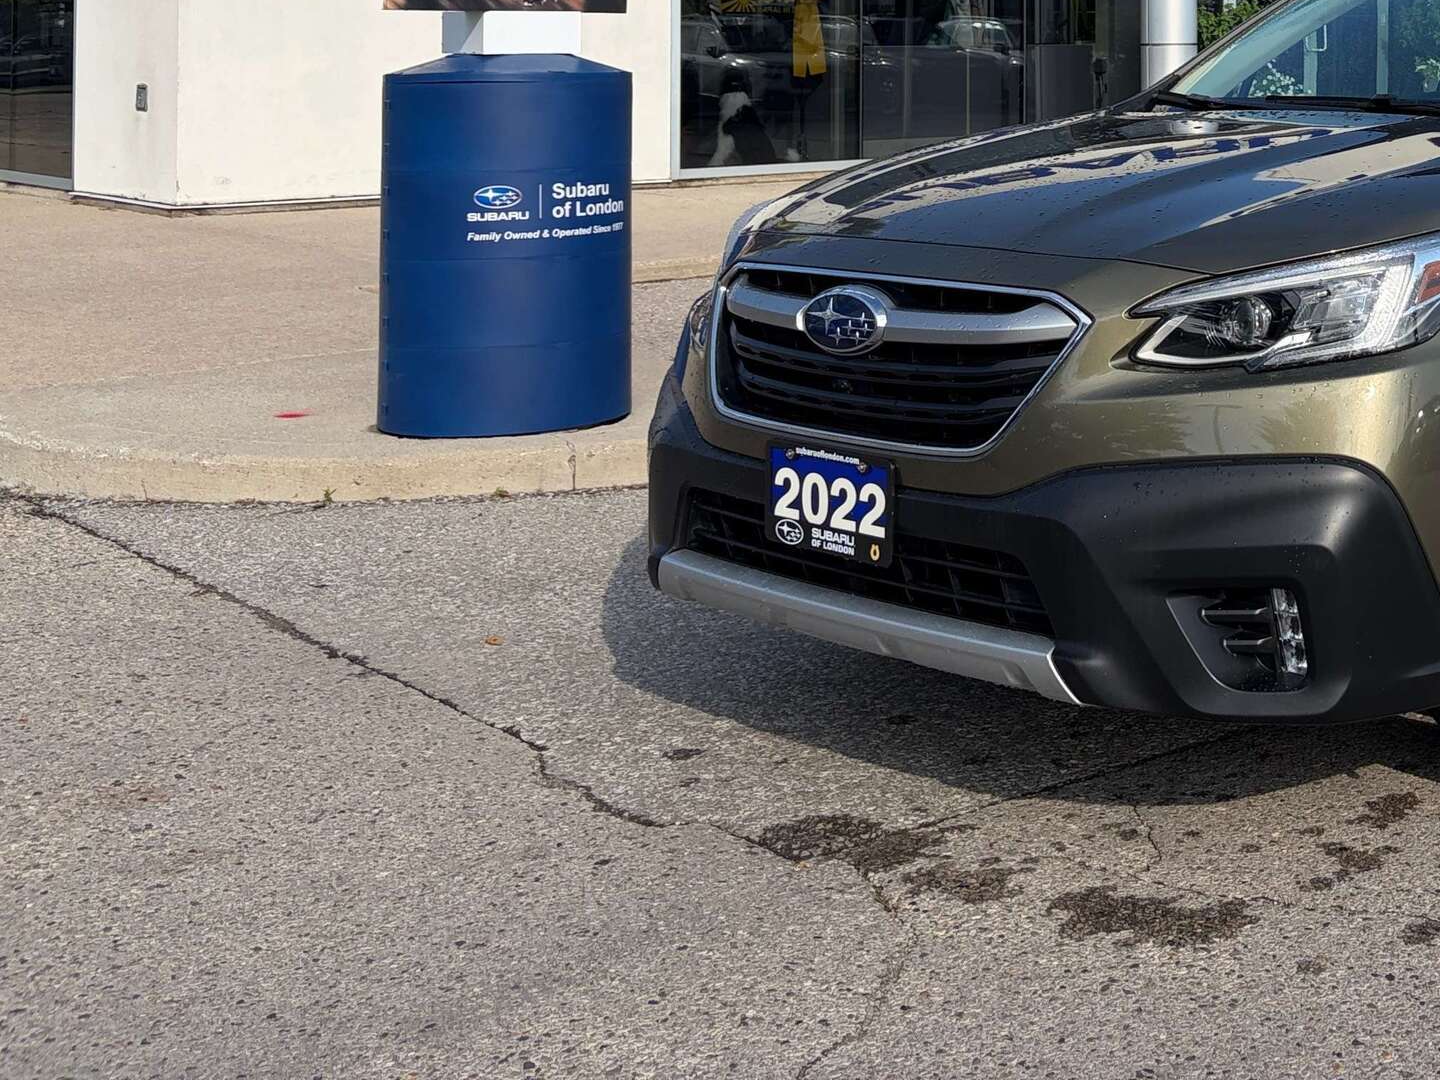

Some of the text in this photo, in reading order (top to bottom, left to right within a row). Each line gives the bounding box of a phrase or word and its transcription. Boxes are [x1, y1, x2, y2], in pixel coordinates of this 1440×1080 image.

[552, 182, 609, 199] Subaru
[467, 211, 529, 222] SUBARU
[552, 198, 624, 218] of London
[467, 231, 501, 242] Family
[504, 229, 540, 240] Owned
[542, 229, 550, 238] &
[552, 226, 592, 238] Operated
[593, 223, 611, 234] Since
[796, 446, 860, 465] subaruoflondon.com
[774, 467, 886, 538] 2022
[811, 527, 855, 546] SUBARU
[811, 539, 855, 556] OF LONDON
